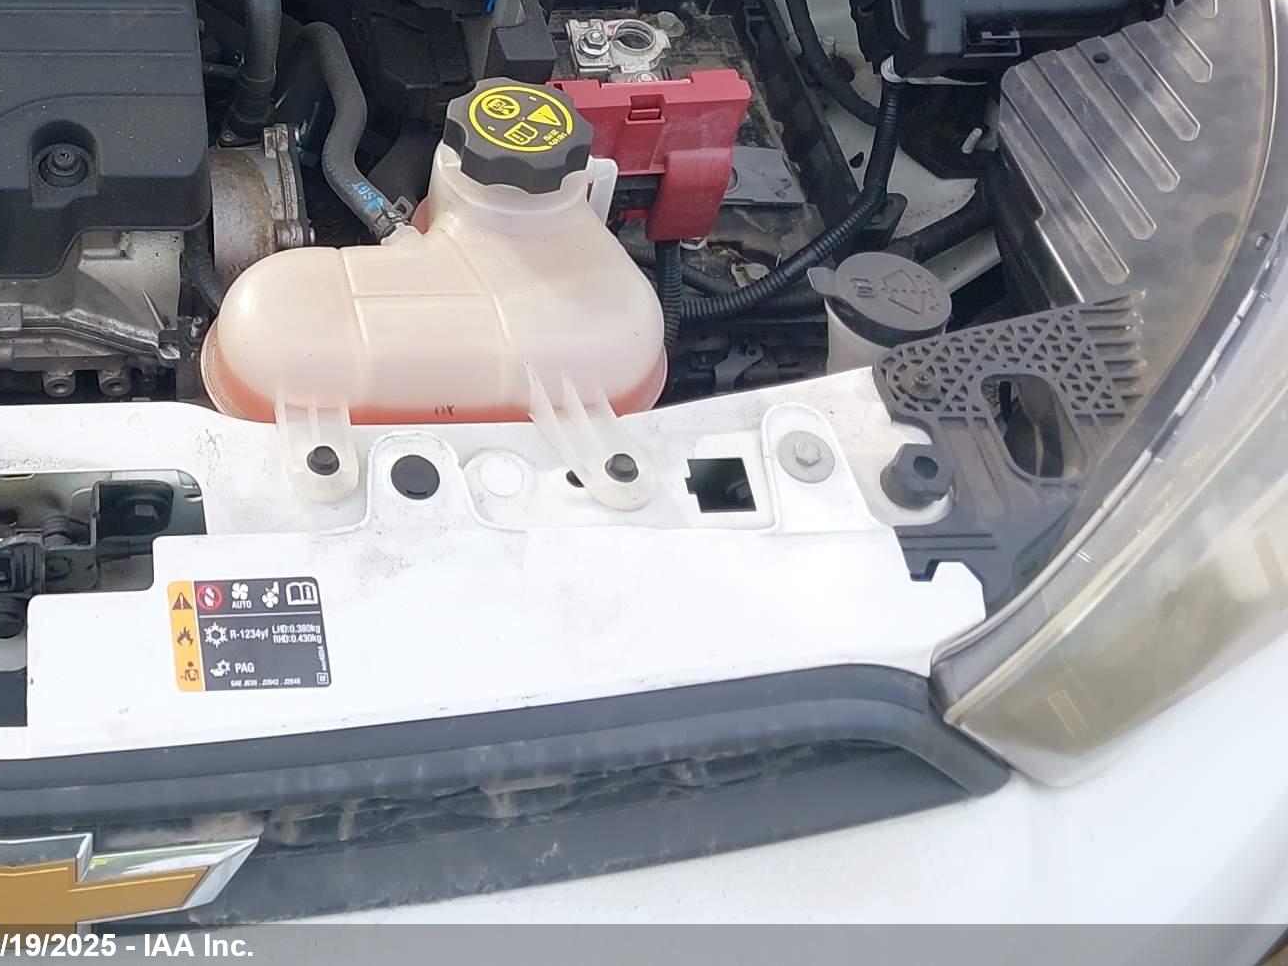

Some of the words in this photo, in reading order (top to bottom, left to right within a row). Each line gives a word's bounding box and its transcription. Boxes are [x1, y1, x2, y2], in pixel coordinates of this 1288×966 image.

[231, 599, 252, 609] AUTO
[229, 628, 269, 641] R-1234yf
[234, 662, 255, 673] PAG
